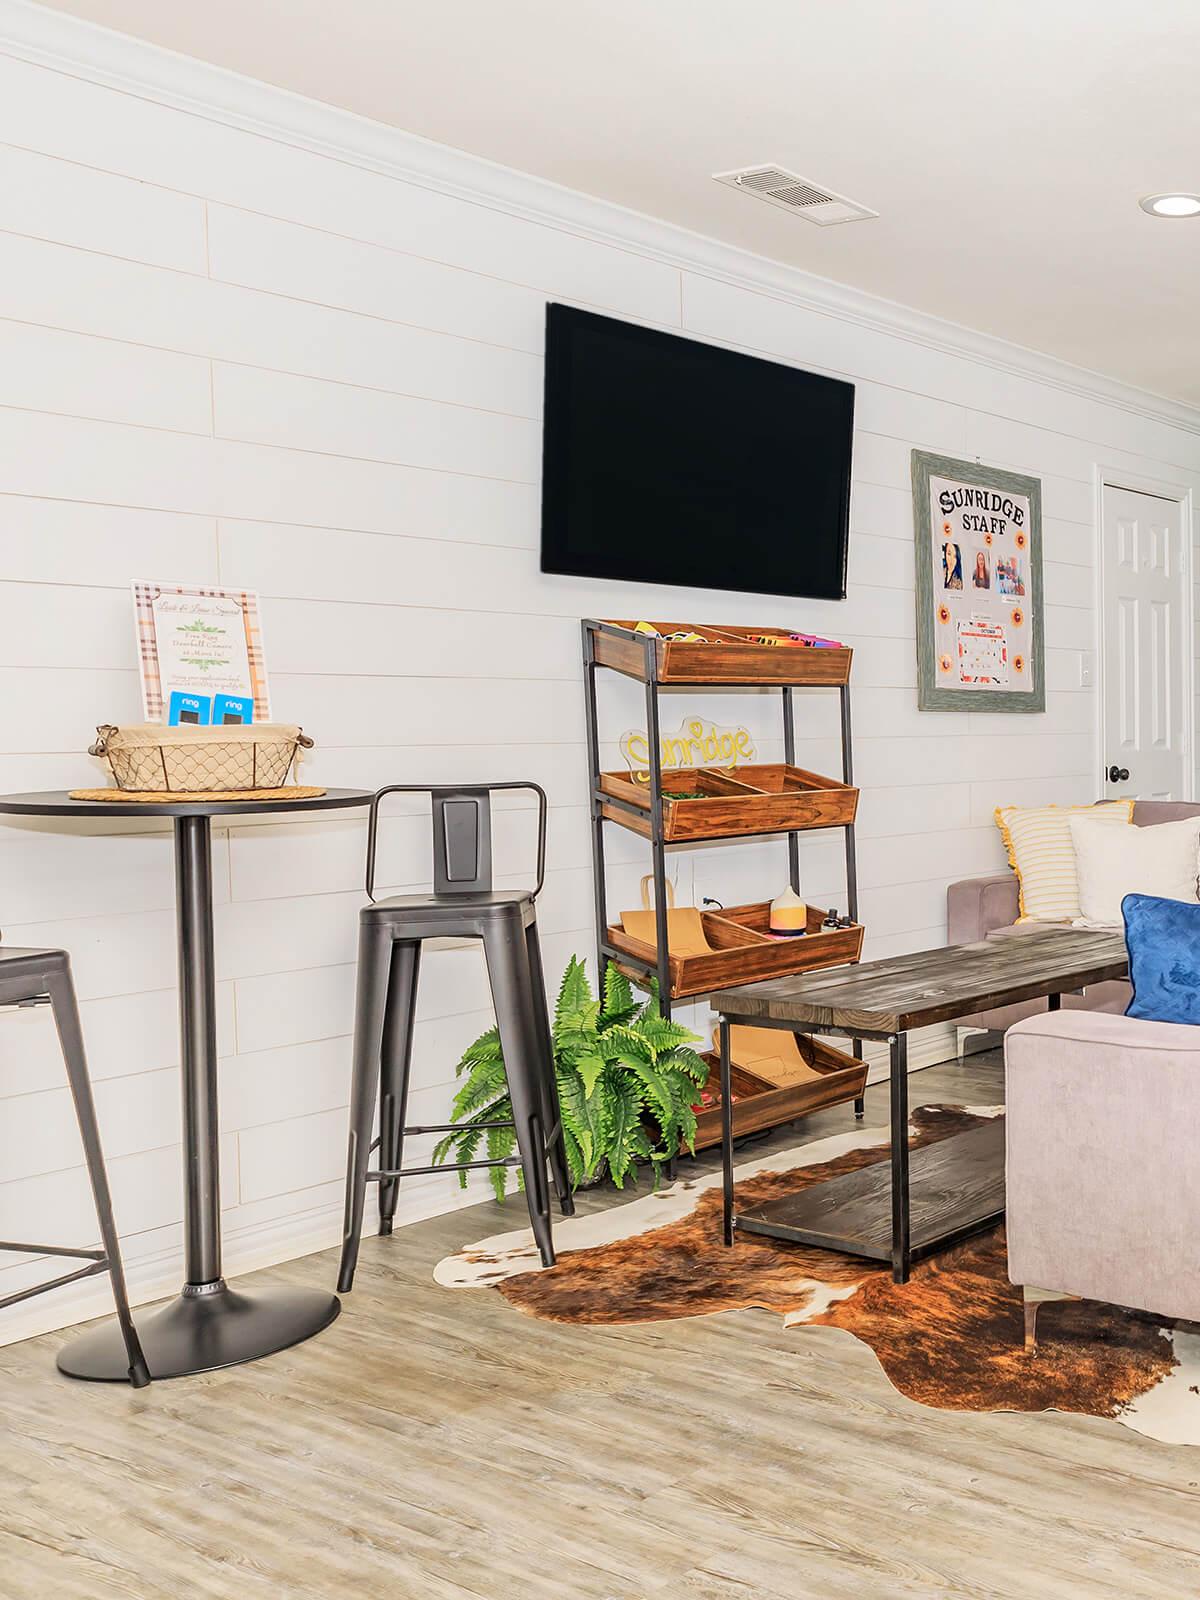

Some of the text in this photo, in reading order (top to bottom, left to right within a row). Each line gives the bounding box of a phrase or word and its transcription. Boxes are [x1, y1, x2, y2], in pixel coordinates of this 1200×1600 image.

[939, 488, 1024, 527] SUNRIDGE
[962, 513, 1007, 535] STAFF
[182, 698, 200, 709] ring
[225, 700, 243, 712] ring
